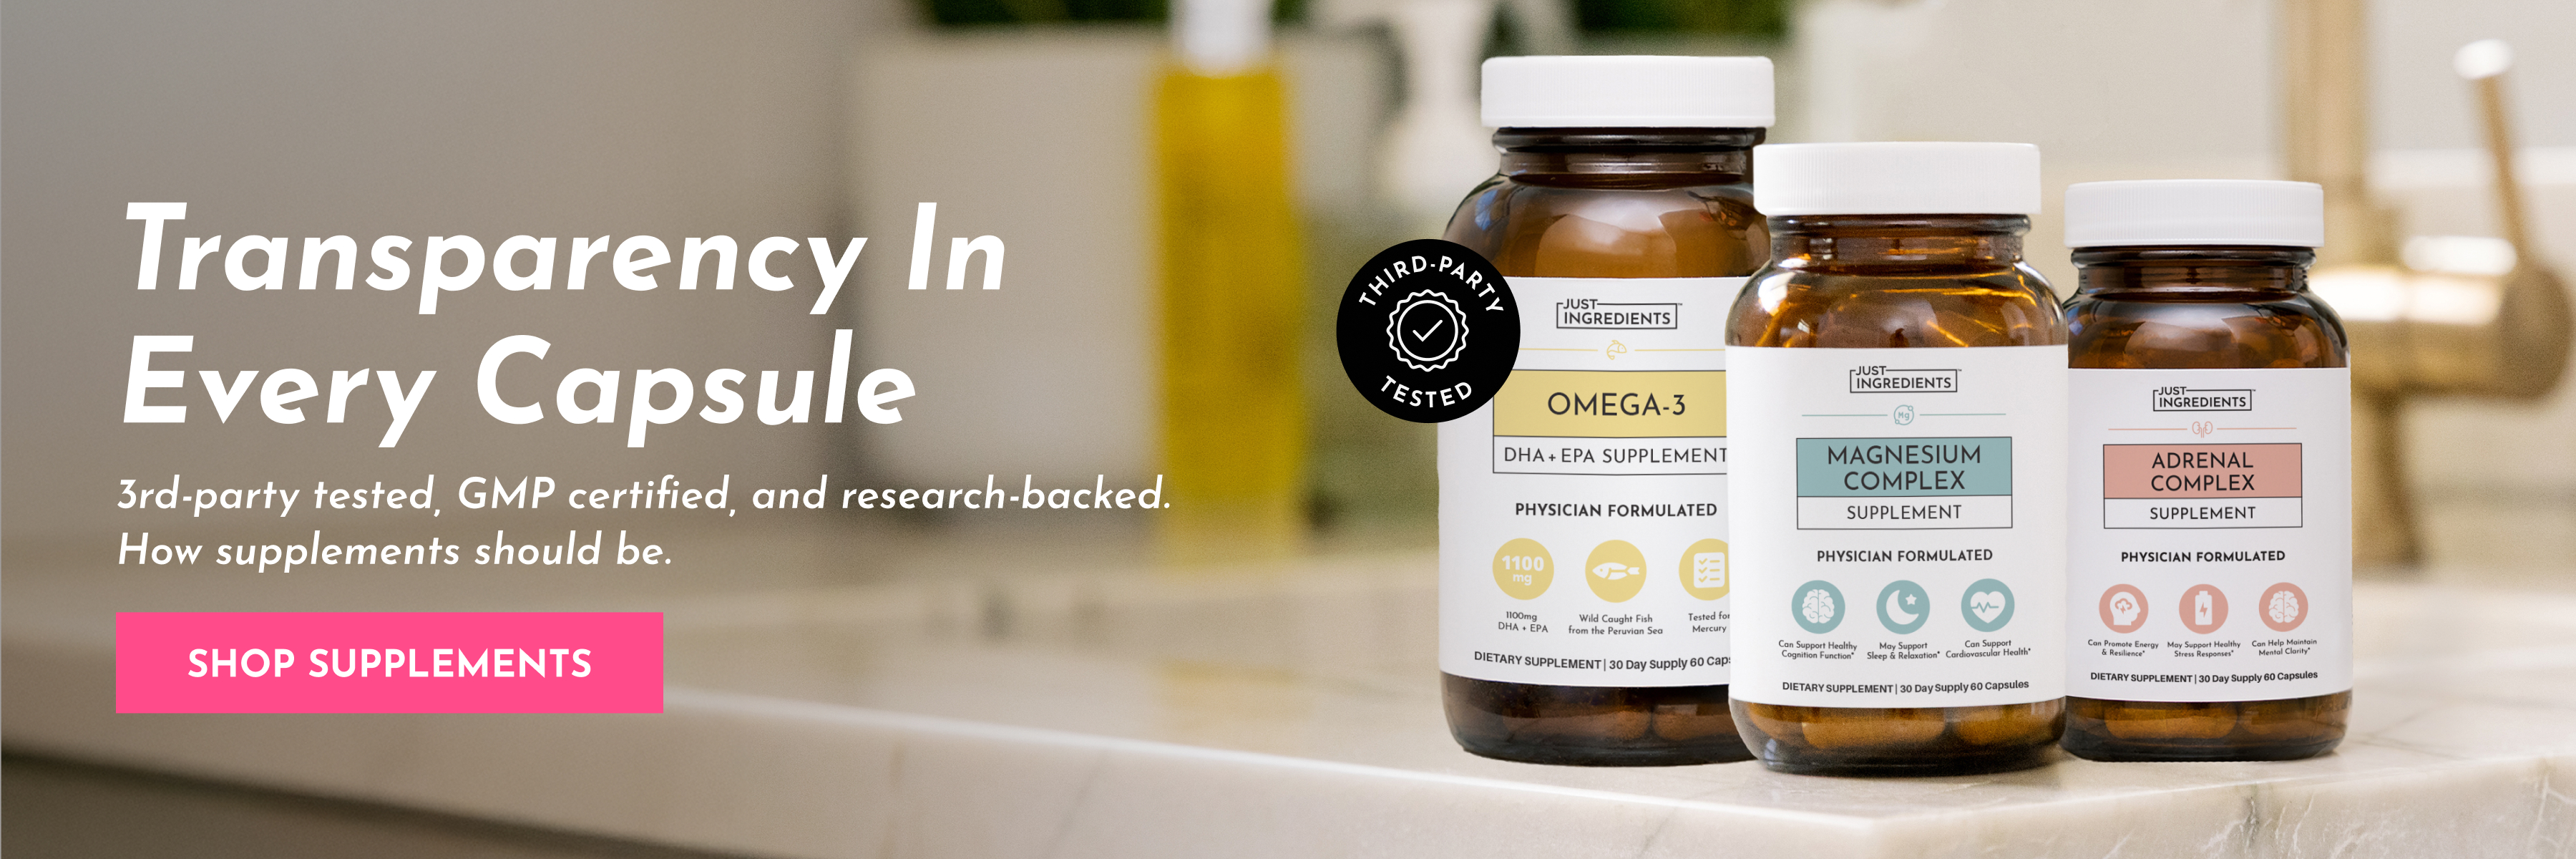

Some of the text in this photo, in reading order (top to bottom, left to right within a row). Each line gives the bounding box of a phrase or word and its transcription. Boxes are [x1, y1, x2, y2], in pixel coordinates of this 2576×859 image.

[1563, 299, 1598, 309] JUST
[1565, 312, 1670, 324] INGREDIENTS
[1855, 366, 1886, 375] JUST
[1858, 377, 1951, 389] INGREDIENTS
[2159, 387, 2187, 395] JUST
[1548, 392, 1685, 415] OMEGA-3
[2160, 397, 2245, 407] INGREDIENTS
[1898, 412, 1909, 420] Mg
[1505, 447, 1544, 462] DHA
[1562, 448, 1594, 462] EPA
[1603, 448, 1727, 463] SUPPLEMENT
[1828, 445, 1980, 464] MAGNESIUM
[2152, 452, 2253, 468] ADRENAL
[1845, 471, 1965, 490] COMPLEX
[2152, 475, 2254, 491] COMPLEX
[1516, 503, 1717, 517] PHYSICIAN FORMULATED
[1848, 505, 1961, 519] SUPPLEMENT
[2150, 507, 2255, 519] SUPPLEMENT
[1818, 549, 1992, 561] PHYSICIAN FORMULATED
[2122, 550, 2285, 562] PHYSICIAN FORMULATED
[1502, 555, 1543, 571] 1100
[1513, 574, 1531, 586] mg
[1506, 611, 1537, 622] 1100mg
[1602, 614, 1632, 624] Caught
[1689, 611, 1715, 621] Tested
[1498, 622, 1518, 631] DHA
[1568, 625, 1588, 634] from
[1652, 626, 1664, 635] Sea
[1797, 641, 1825, 650] Support
[1828, 641, 1857, 651] Healthy
[1898, 642, 1927, 651] Support
[1983, 640, 2011, 649] Support
[1782, 650, 1817, 659] Cognition
[1868, 651, 1887, 661] Sleep
[1946, 649, 2001, 658] Cardiovascular
[1475, 651, 1522, 664] DIETARY
[1525, 656, 1601, 669] SUPPLEMENT
[1609, 660, 1623, 669] 30
[1626, 660, 1646, 671] Day
[1650, 658, 1687, 670] Supply
[1690, 657, 1704, 666] 60
[2212, 675, 2229, 684] Day
[2232, 674, 2262, 683] Supply
[2278, 671, 2318, 681] Capsules
[1783, 682, 1824, 691] DIETARY
[1915, 685, 1933, 694] Day
[1935, 683, 1968, 693] Supply
[1985, 680, 2029, 691] Capsules
